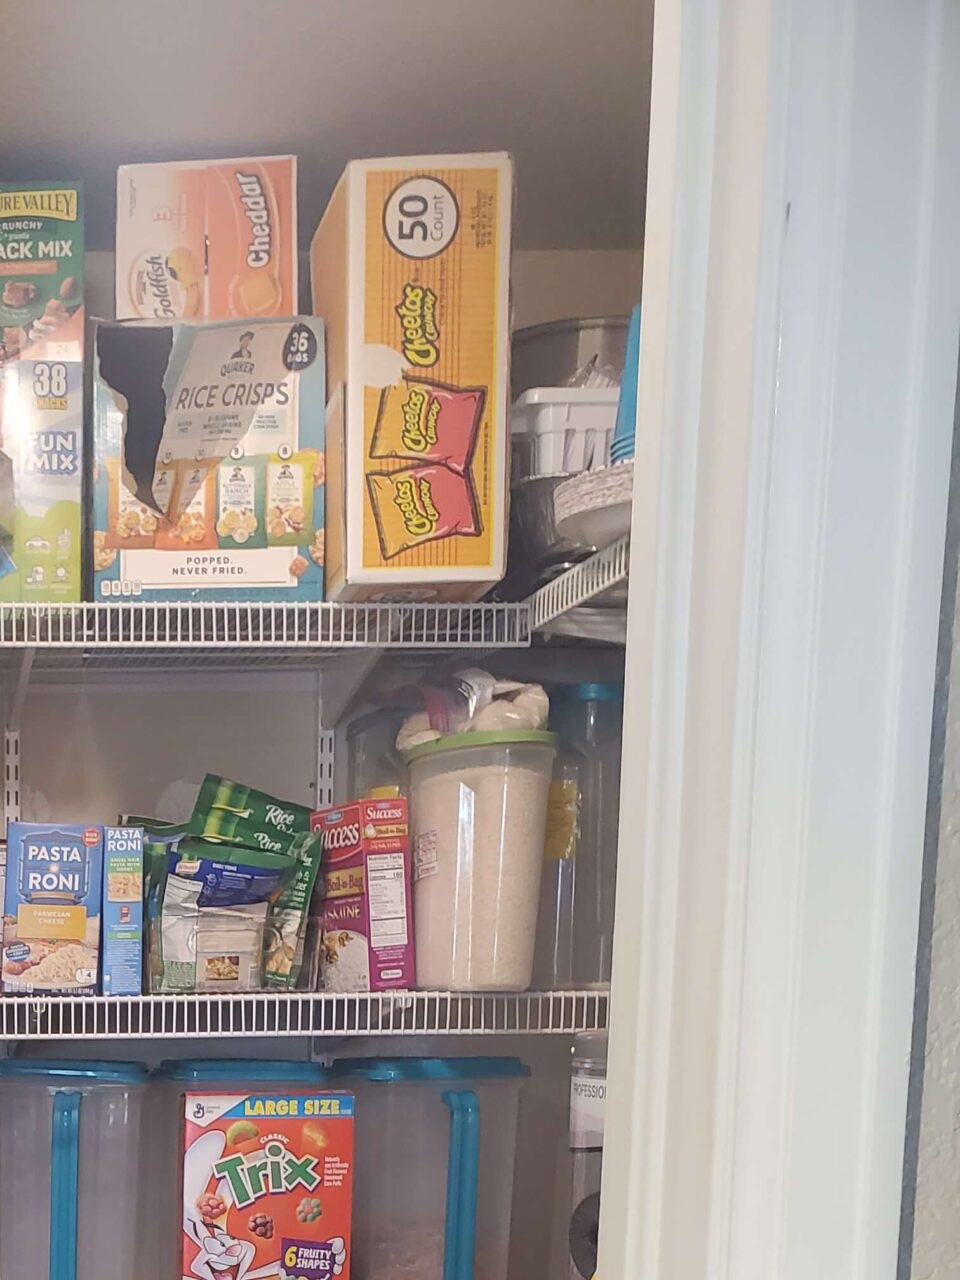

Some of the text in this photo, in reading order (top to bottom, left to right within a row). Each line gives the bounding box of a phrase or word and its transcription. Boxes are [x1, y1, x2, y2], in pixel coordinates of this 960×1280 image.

[24, 193, 74, 217] VALLEY
[236, 172, 272, 268] Cheddar
[398, 194, 429, 242] 50
[431, 194, 445, 242] Count
[37, 240, 73, 258] MIX
[145, 253, 176, 320] Goldfish
[397, 284, 438, 367] Cheetos
[290, 332, 309, 352] 36
[220, 361, 255, 376] QUAKER
[34, 362, 68, 398] 38
[176, 382, 289, 410] RICE CRISPS
[401, 390, 428, 452] Cheetos
[26, 453, 77, 472] MIX
[394, 480, 433, 535] Cheetos
[186, 556, 233, 565] POPPED.
[172, 566, 247, 575] NEVER FRIED.
[265, 804, 295, 826] Rice
[107, 830, 141, 840] PASTA
[254, 832, 282, 851] Rice
[28, 845, 82, 862] PASTA
[107, 840, 141, 851] RONI
[28, 873, 79, 891] RONI
[325, 905, 361, 920] SMINE
[244, 1099, 340, 1116] LARGE SIZE
[259, 1133, 290, 1145] CLASSIC
[212, 1141, 321, 1210] Trix
[284, 1246, 297, 1267] 6
[298, 1247, 332, 1260] FRUITY
[296, 1257, 331, 1270] SHAPES
